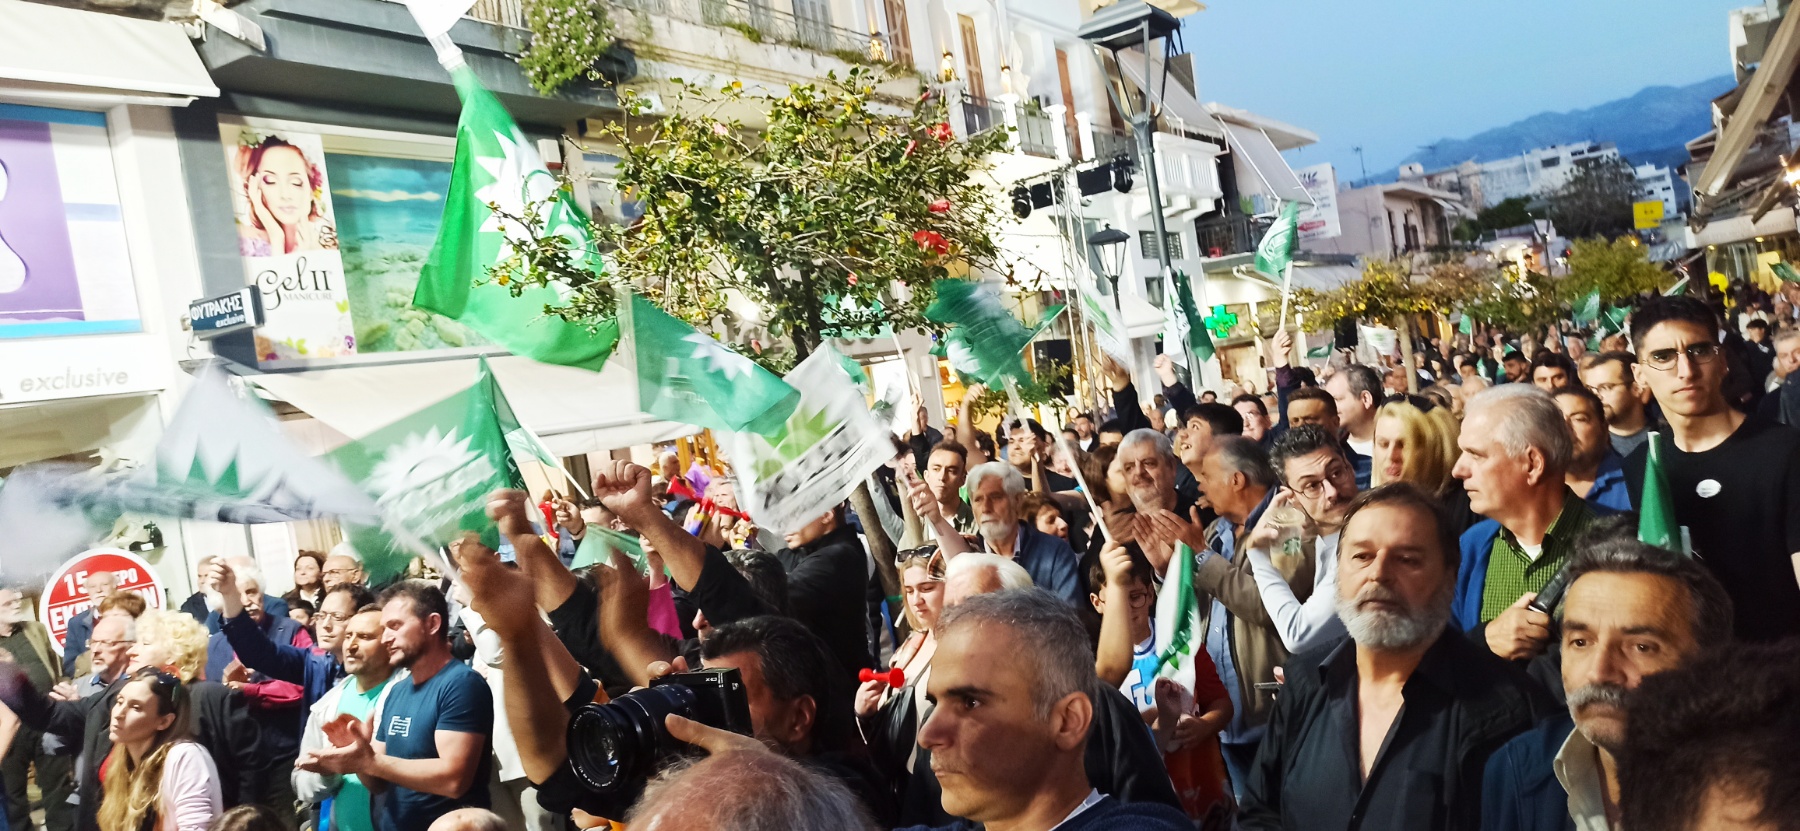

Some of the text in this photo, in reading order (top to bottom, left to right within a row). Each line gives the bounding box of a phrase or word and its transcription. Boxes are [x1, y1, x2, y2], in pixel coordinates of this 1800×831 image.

[255, 256, 308, 310] Gel
[190, 295, 243, 321] ΦΥΤΡΑΚΗΣ
[283, 292, 333, 301] MANICURE
[215, 313, 245, 328] exclusive
[20, 366, 129, 393] exclusive
